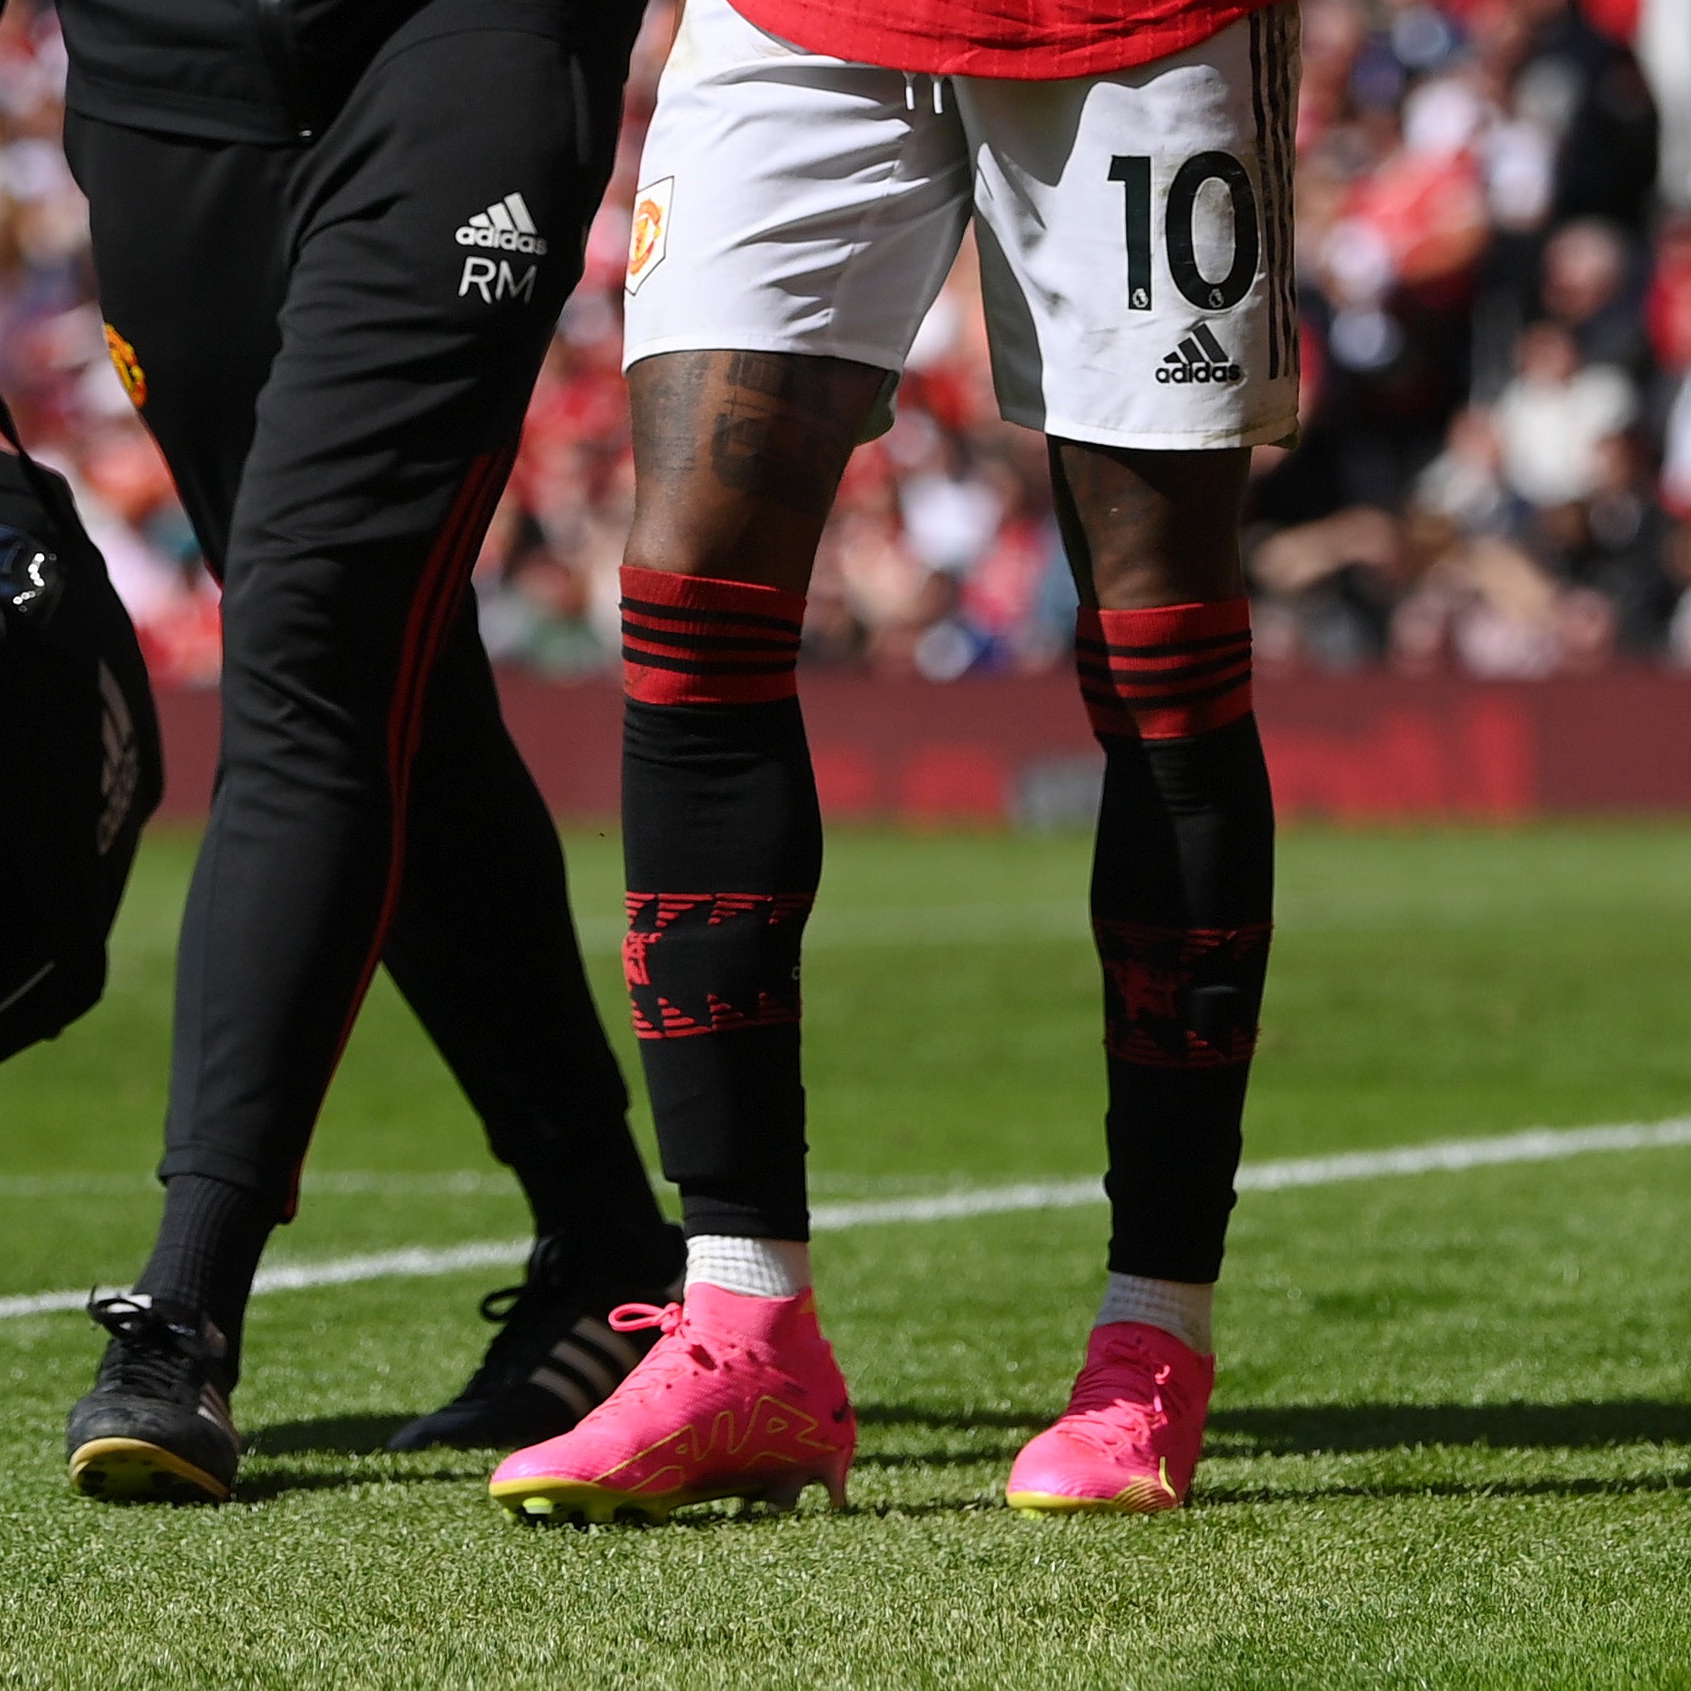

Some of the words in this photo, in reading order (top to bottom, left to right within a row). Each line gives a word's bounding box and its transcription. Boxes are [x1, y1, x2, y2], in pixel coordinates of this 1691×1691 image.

[454, 225, 548, 256] adidas
[1107, 150, 1259, 311] 10
[457, 255, 538, 306] RM
[1155, 361, 1242, 384] adidas
